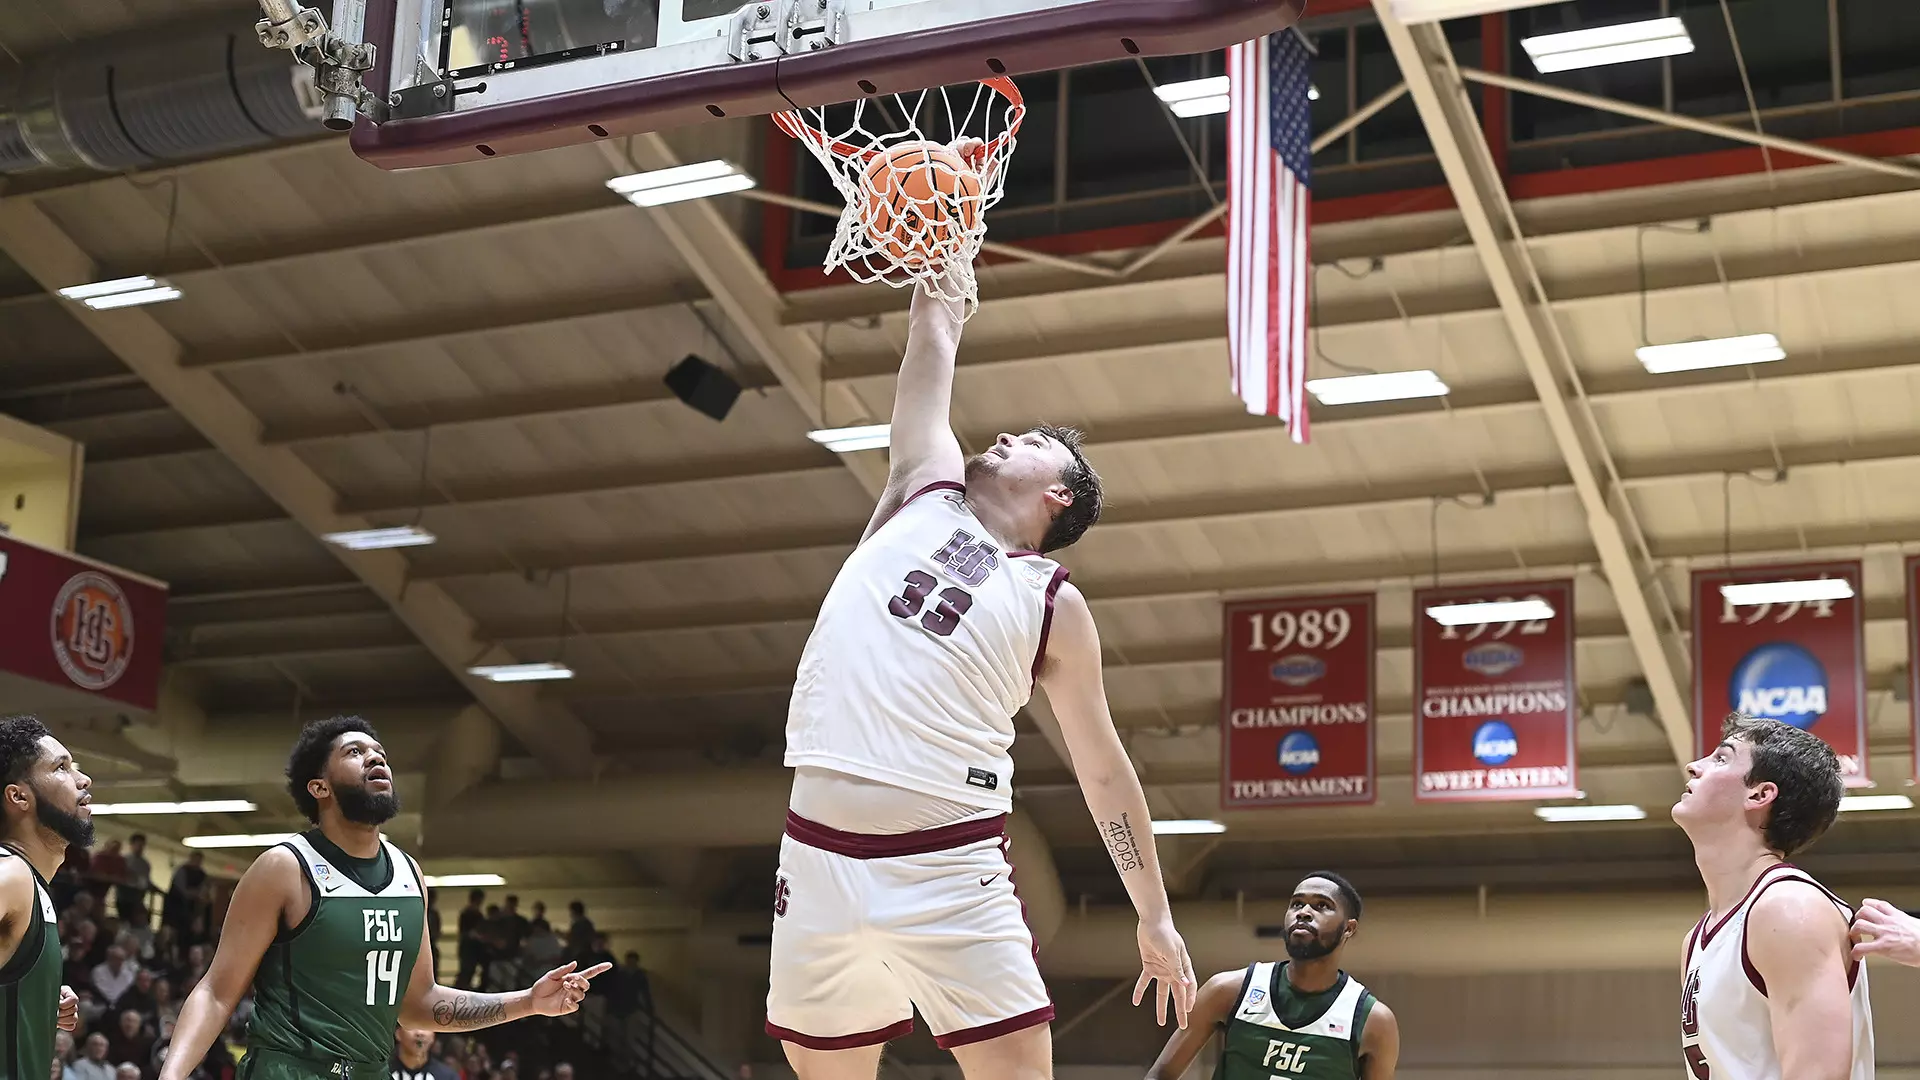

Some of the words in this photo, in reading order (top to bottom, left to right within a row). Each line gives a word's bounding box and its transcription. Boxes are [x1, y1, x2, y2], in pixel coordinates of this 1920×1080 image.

[888, 569, 974, 637] 33
[1247, 607, 1351, 652] 1989
[1231, 702, 1367, 729] CHAMPIONS
[1423, 691, 1566, 718] CHAMPIONS
[1737, 685, 1828, 717] NCAA
[1232, 776, 1367, 798] TOURNAMENT
[1421, 769, 1487, 791] SWEET
[1487, 766, 1568, 788] SIXTEEN
[362, 909, 403, 942] FSC
[366, 950, 403, 1006] 14
[1262, 1039, 1312, 1074] FSC
